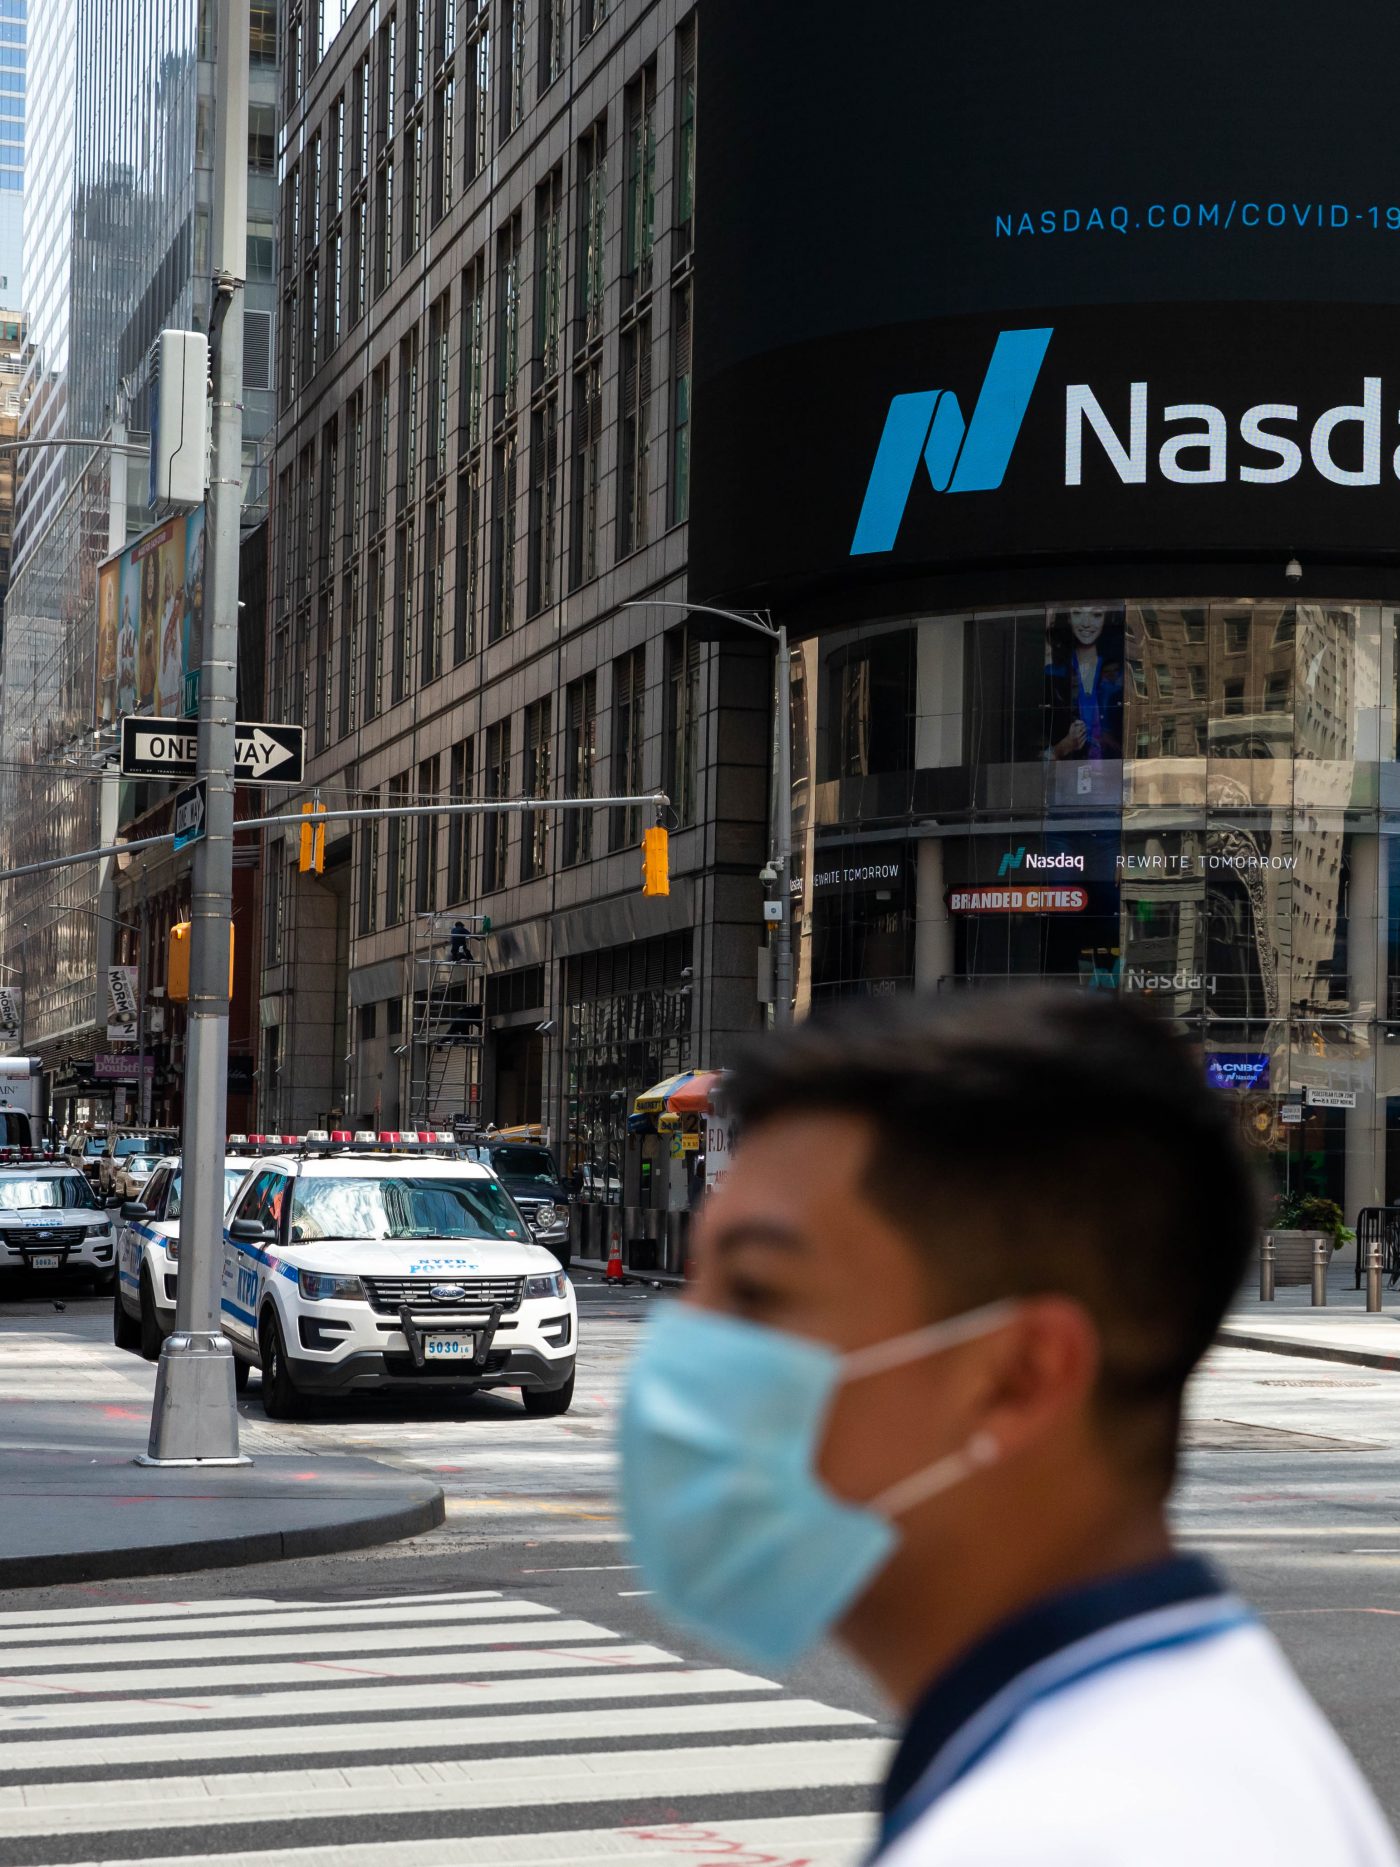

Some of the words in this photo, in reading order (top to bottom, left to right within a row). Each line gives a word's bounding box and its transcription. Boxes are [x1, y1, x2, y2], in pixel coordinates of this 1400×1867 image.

[149, 736, 198, 761] ONE
[1026, 852, 1085, 871] Nasdaq
[1116, 855, 1190, 869] REWRITE
[1198, 856, 1298, 869] TOMORROW
[813, 871, 840, 887] EWRITE
[951, 892, 1023, 910] BRANDED
[1026, 891, 1083, 908] CITIES
[1223, 1063, 1264, 1072] CNBC
[429, 1341, 459, 1354] 5030
